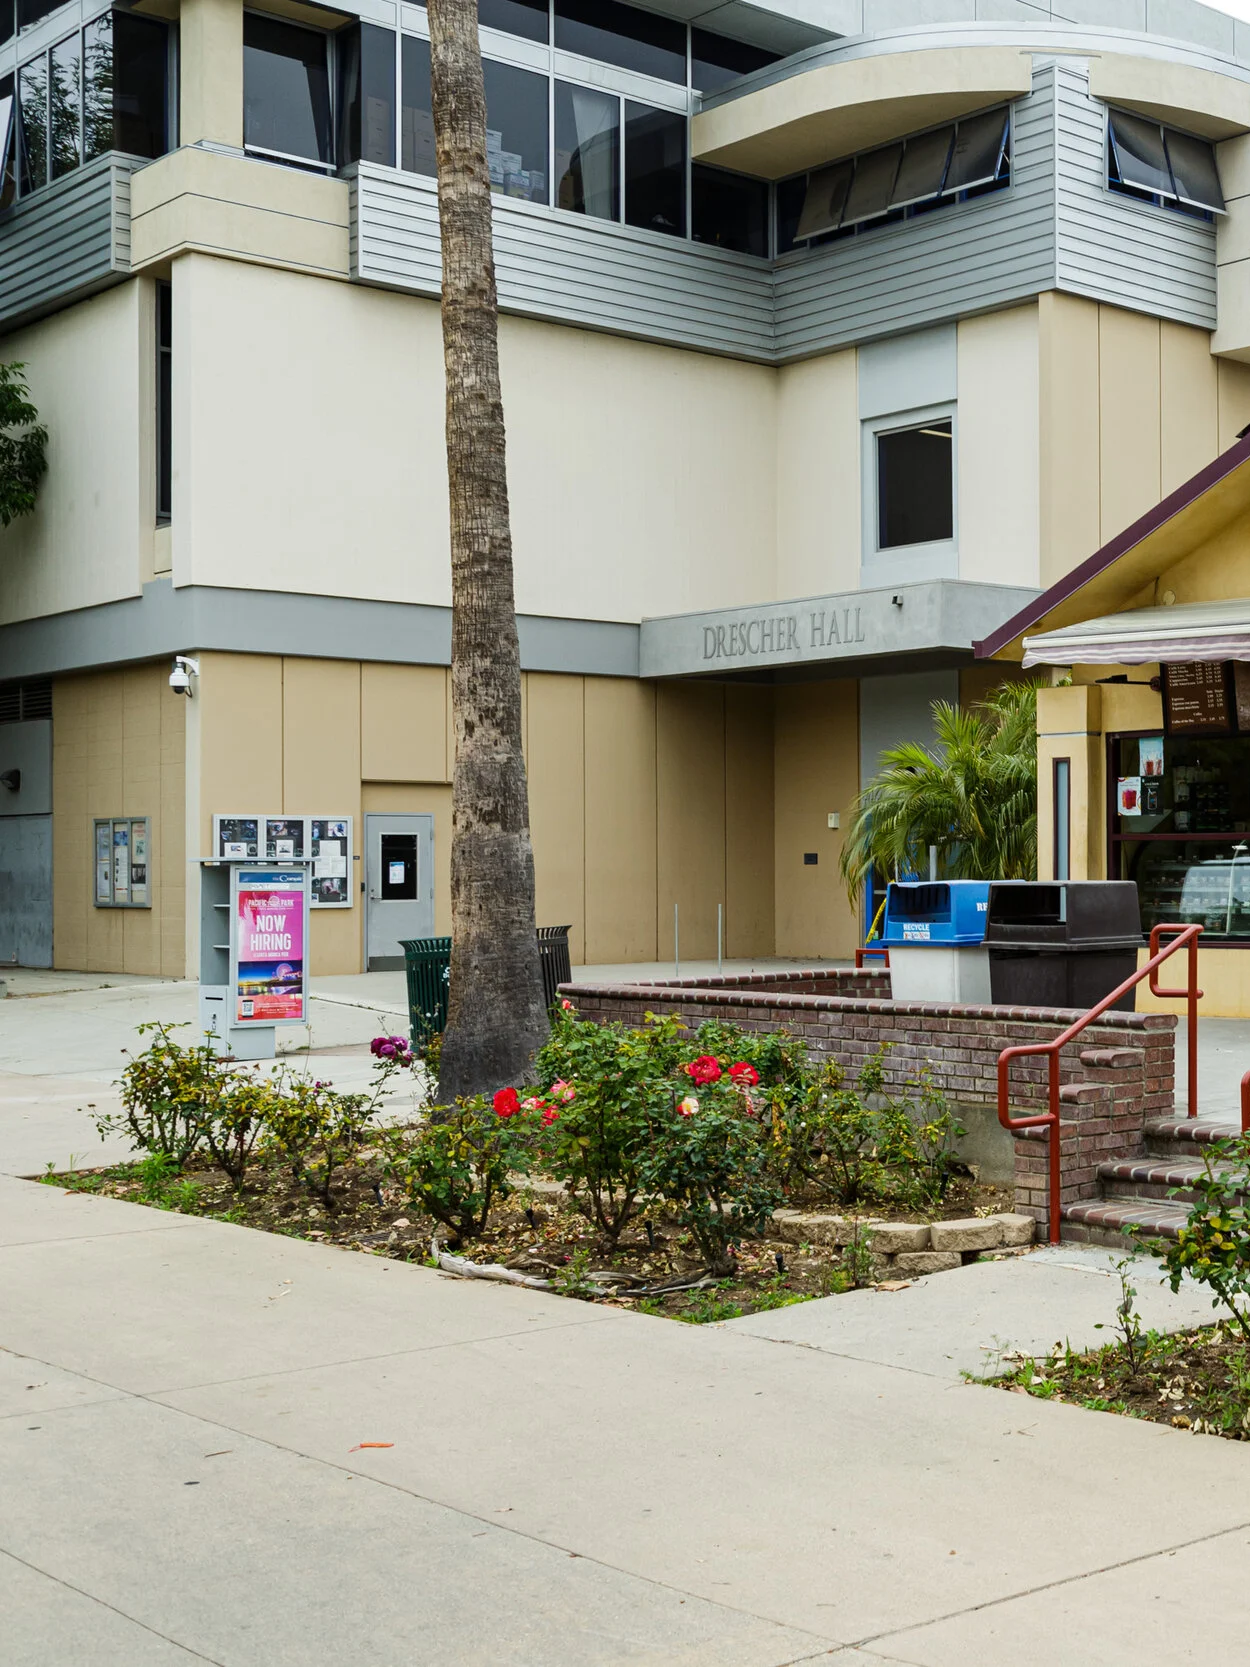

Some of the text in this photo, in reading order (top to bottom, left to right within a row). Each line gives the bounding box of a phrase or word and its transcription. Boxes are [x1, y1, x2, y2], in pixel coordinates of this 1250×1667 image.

[702, 607, 866, 660] DRESCHER HALL
[256, 914, 286, 932] NOW
[903, 923, 930, 931] RECYCLE
[250, 933, 292, 951] HIRING
